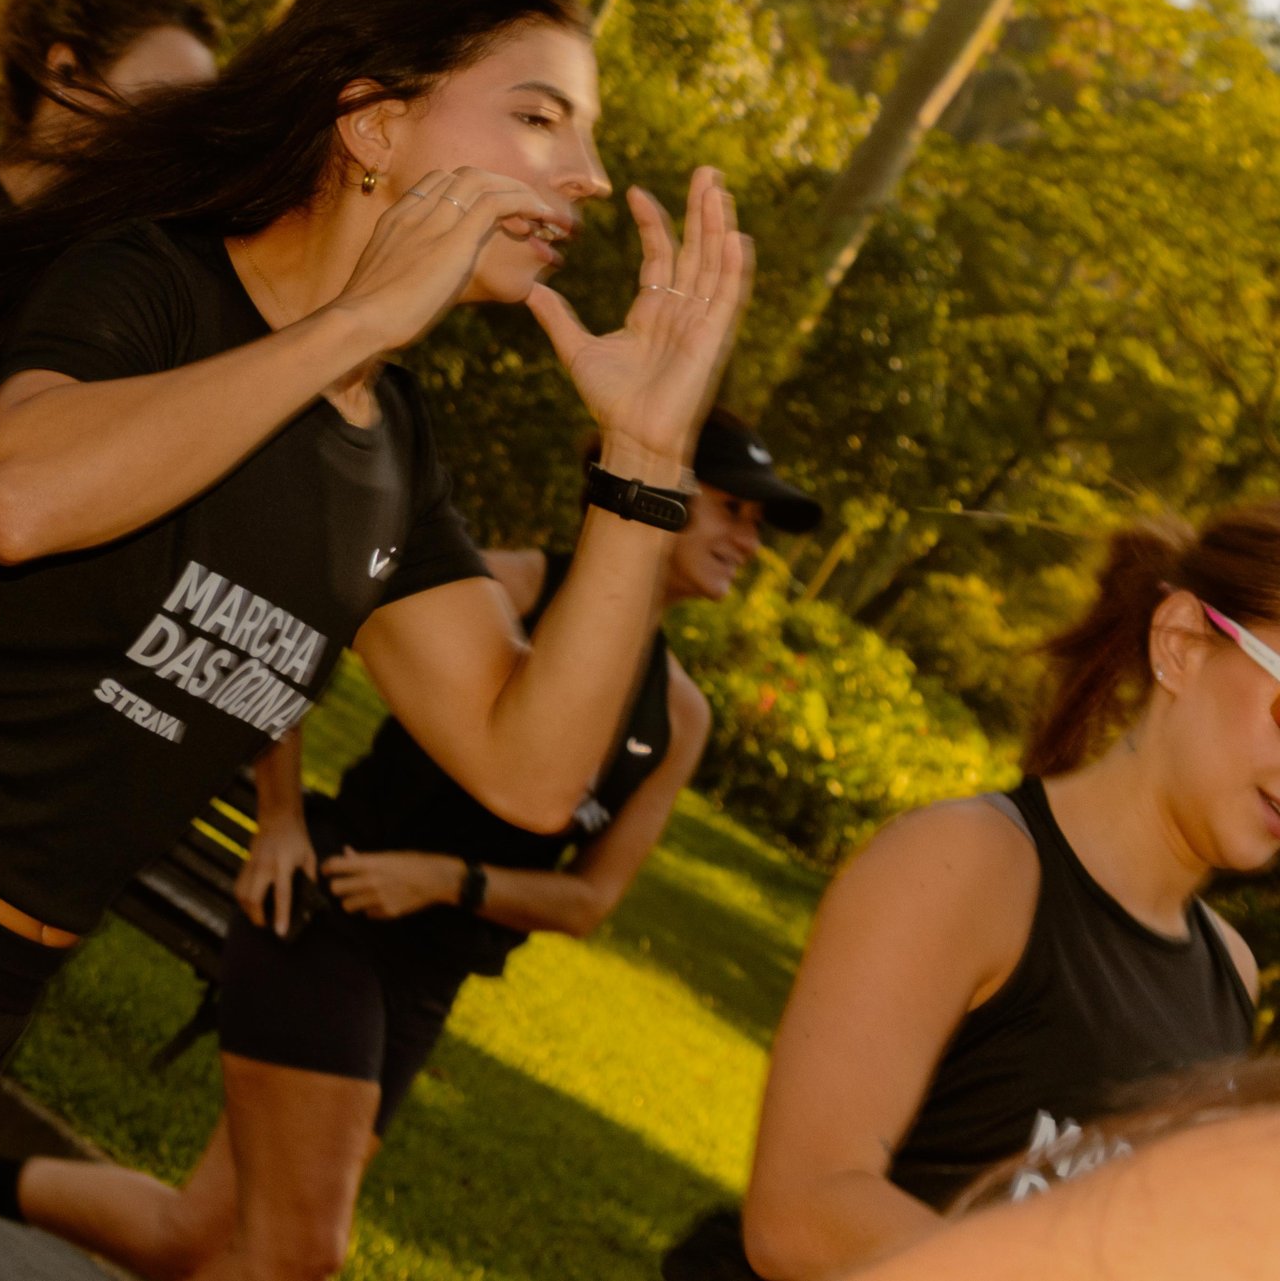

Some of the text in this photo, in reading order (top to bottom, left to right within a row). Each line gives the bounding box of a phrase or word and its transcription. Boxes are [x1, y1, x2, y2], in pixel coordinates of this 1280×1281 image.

[126, 613, 312, 742] DAS MINA
[162, 560, 328, 687] MARCHA
[93, 678, 187, 744] STRAVA
